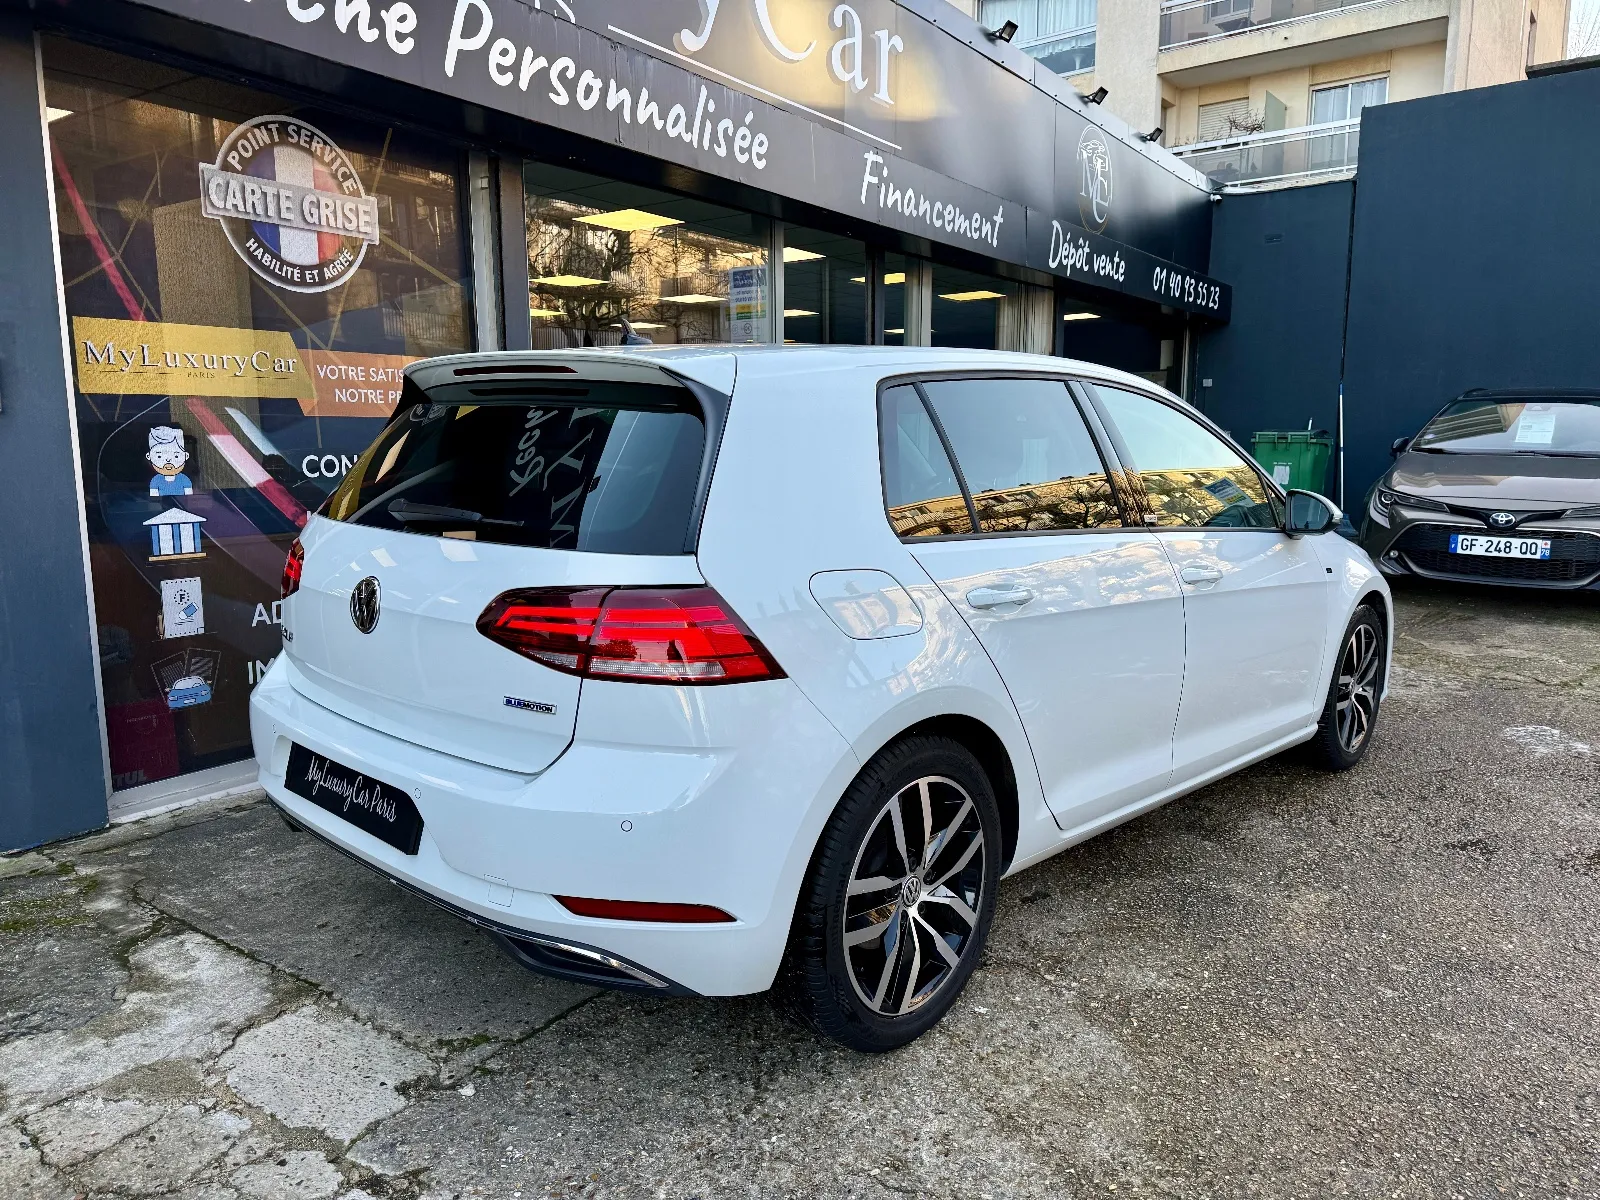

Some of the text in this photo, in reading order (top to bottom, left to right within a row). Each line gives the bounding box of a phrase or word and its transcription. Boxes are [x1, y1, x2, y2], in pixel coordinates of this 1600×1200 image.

[444, 0, 769, 170] Personnalisée
[227, 123, 358, 195] POINT SERVICE
[208, 176, 373, 234] CARTE GRISE
[860, 151, 1004, 248] Financement
[245, 237, 301, 282] HABILITÉ
[305, 269, 320, 283] ET
[1048, 219, 1126, 283] Dépôt vente
[1153, 266, 1220, 310] 01 40 93 55 23
[82, 339, 298, 376] MyLuxuryCar
[187, 371, 215, 380] PARIS
[316, 364, 366, 381] VOTRE
[334, 388, 385, 404] NOTRE
[1460, 538, 1538, 556] GF-248-QQ
[1541, 548, 1550, 556] 78
[369, 784, 397, 823] Paris
